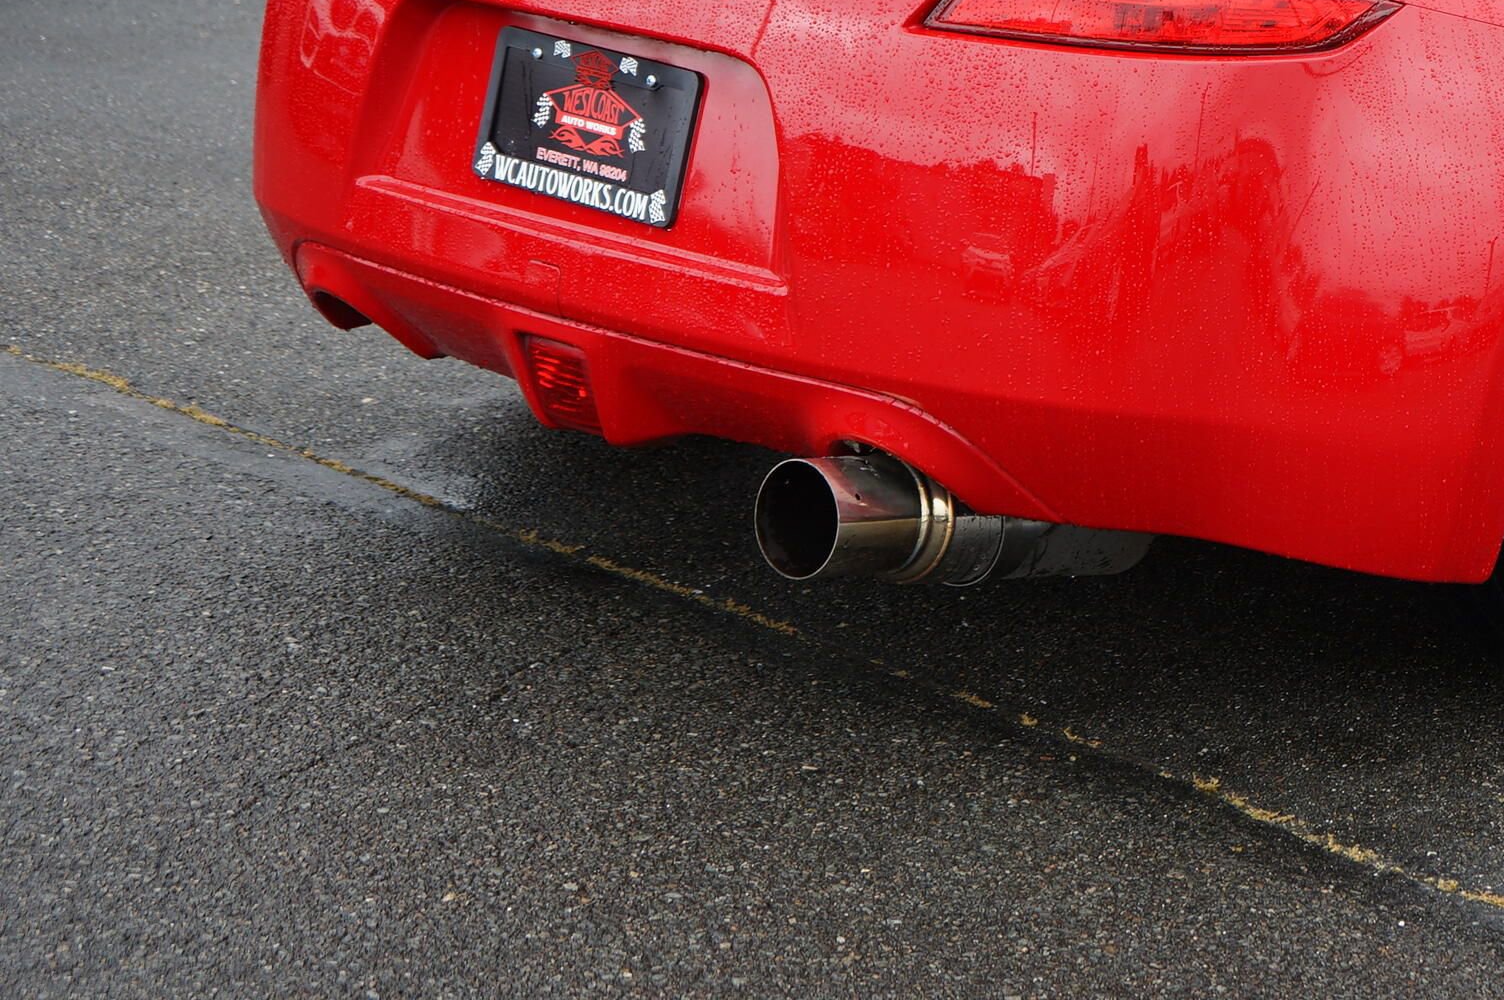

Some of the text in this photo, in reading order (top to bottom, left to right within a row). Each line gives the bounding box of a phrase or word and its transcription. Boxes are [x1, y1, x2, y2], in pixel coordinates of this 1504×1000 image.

[561, 115, 617, 136] AUTO WORKS
[536, 146, 582, 171] EVERETT,
[582, 158, 600, 175] WA
[495, 154, 649, 220] WCAUTOWORKS.COM
